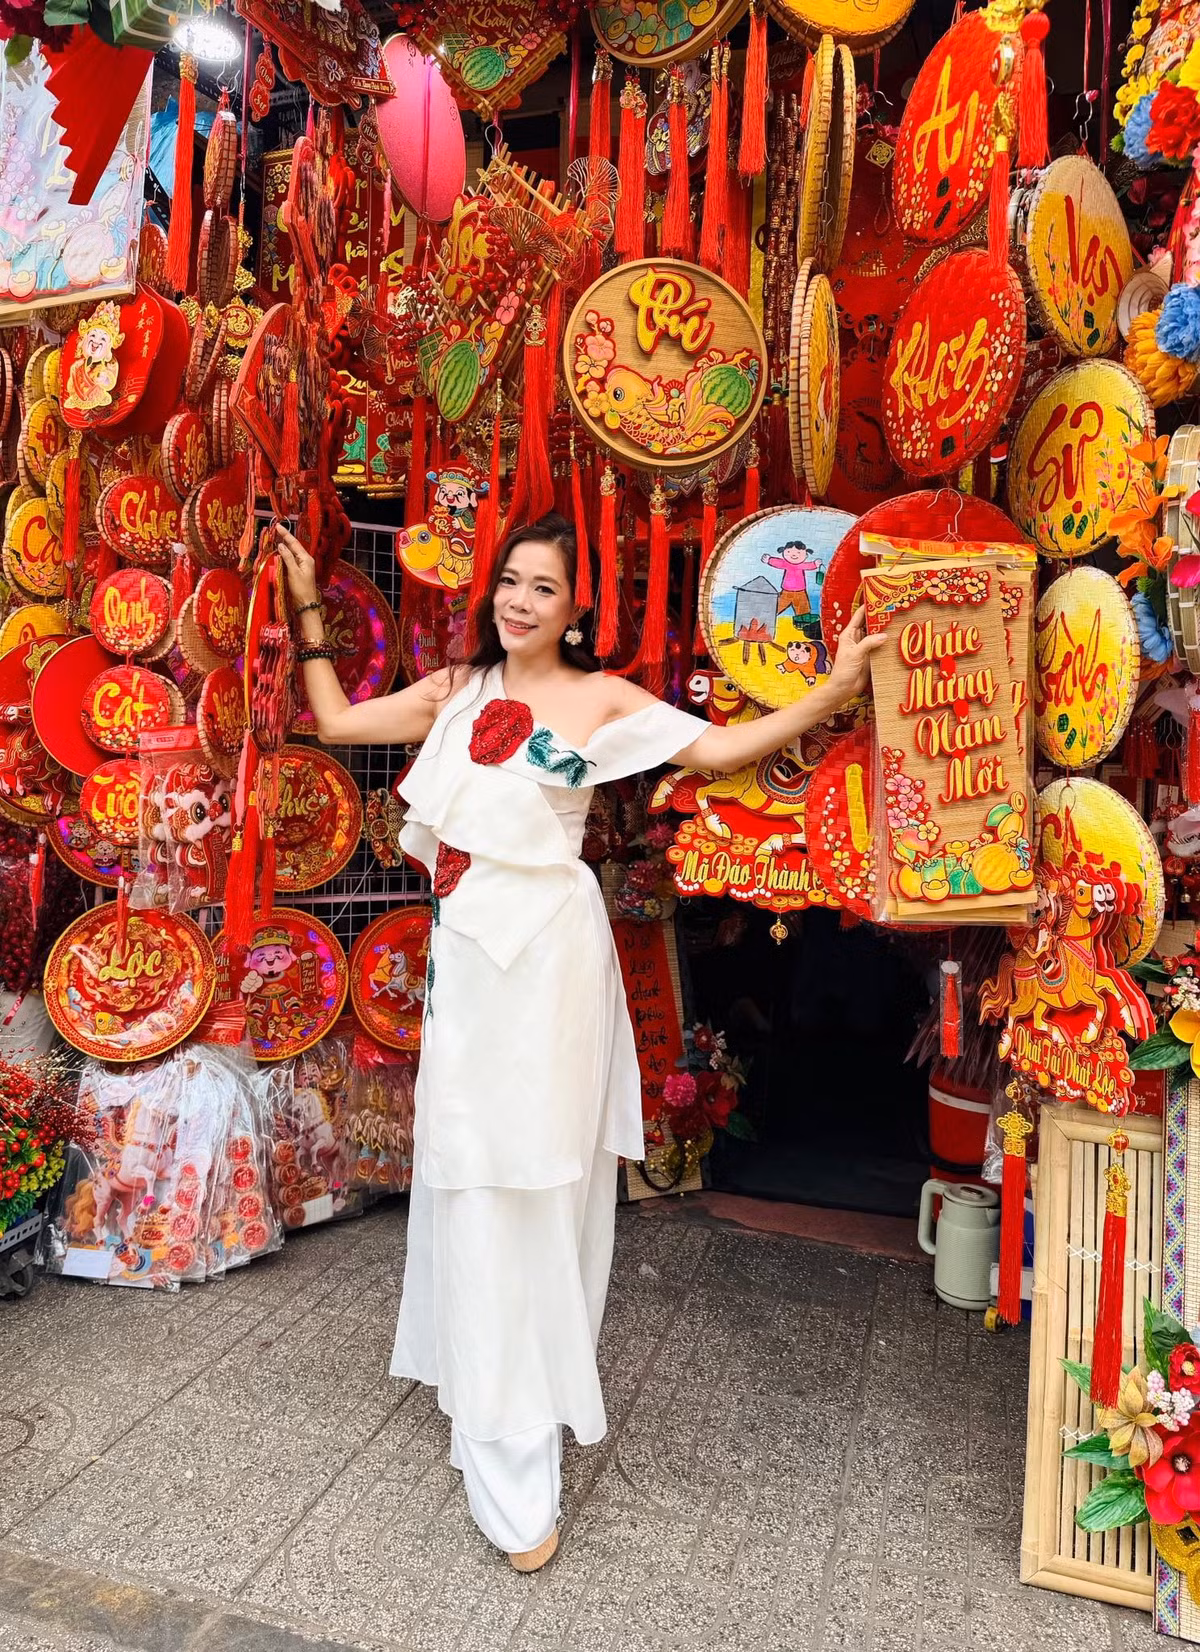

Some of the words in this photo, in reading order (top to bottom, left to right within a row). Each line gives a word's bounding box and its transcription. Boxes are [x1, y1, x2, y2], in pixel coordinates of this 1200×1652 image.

[628, 266, 714, 354] Phúc
[900, 619, 983, 666] Chúc
[93, 671, 155, 732] Cát
[901, 665, 1001, 713] Mừng
[917, 711, 1008, 758] Năm
[938, 754, 1009, 805] Mới
[681, 851, 709, 882] Mã
[711, 852, 751, 885] Đáo
[754, 854, 811, 891] Thành
[99, 939, 163, 988] Lộc
[1014, 1026, 1042, 1064] Phát
[1041, 1038, 1062, 1075] Tài
[1062, 1045, 1092, 1089] Phát
